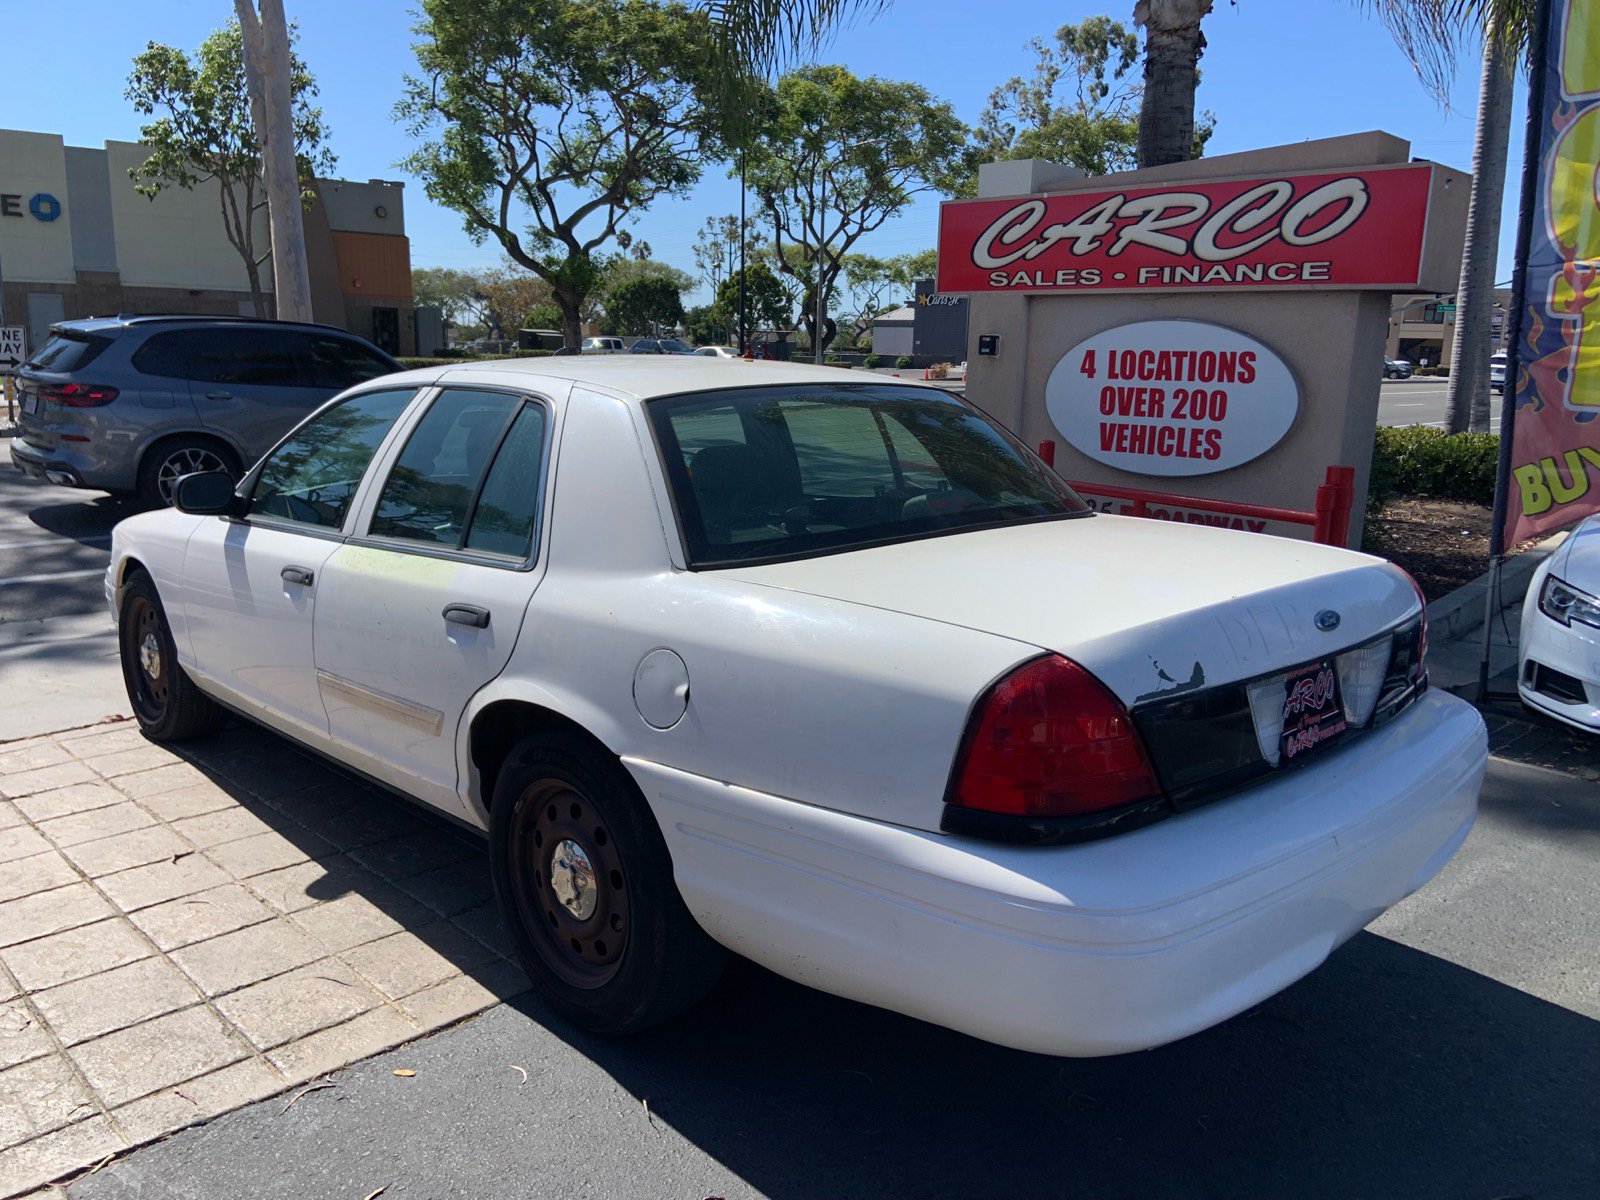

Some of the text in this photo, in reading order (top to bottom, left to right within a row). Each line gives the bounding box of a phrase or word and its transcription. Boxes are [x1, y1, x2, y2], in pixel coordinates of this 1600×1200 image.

[971, 176, 1370, 269] CARCO
[988, 261, 1332, 287] SALES FINANCE
[0, 343, 21, 353] AY
[1080, 350, 1256, 384] 4 LOCATIONS
[1100, 386, 1227, 422] OVER 200
[1100, 423, 1222, 461] VEHICLES
